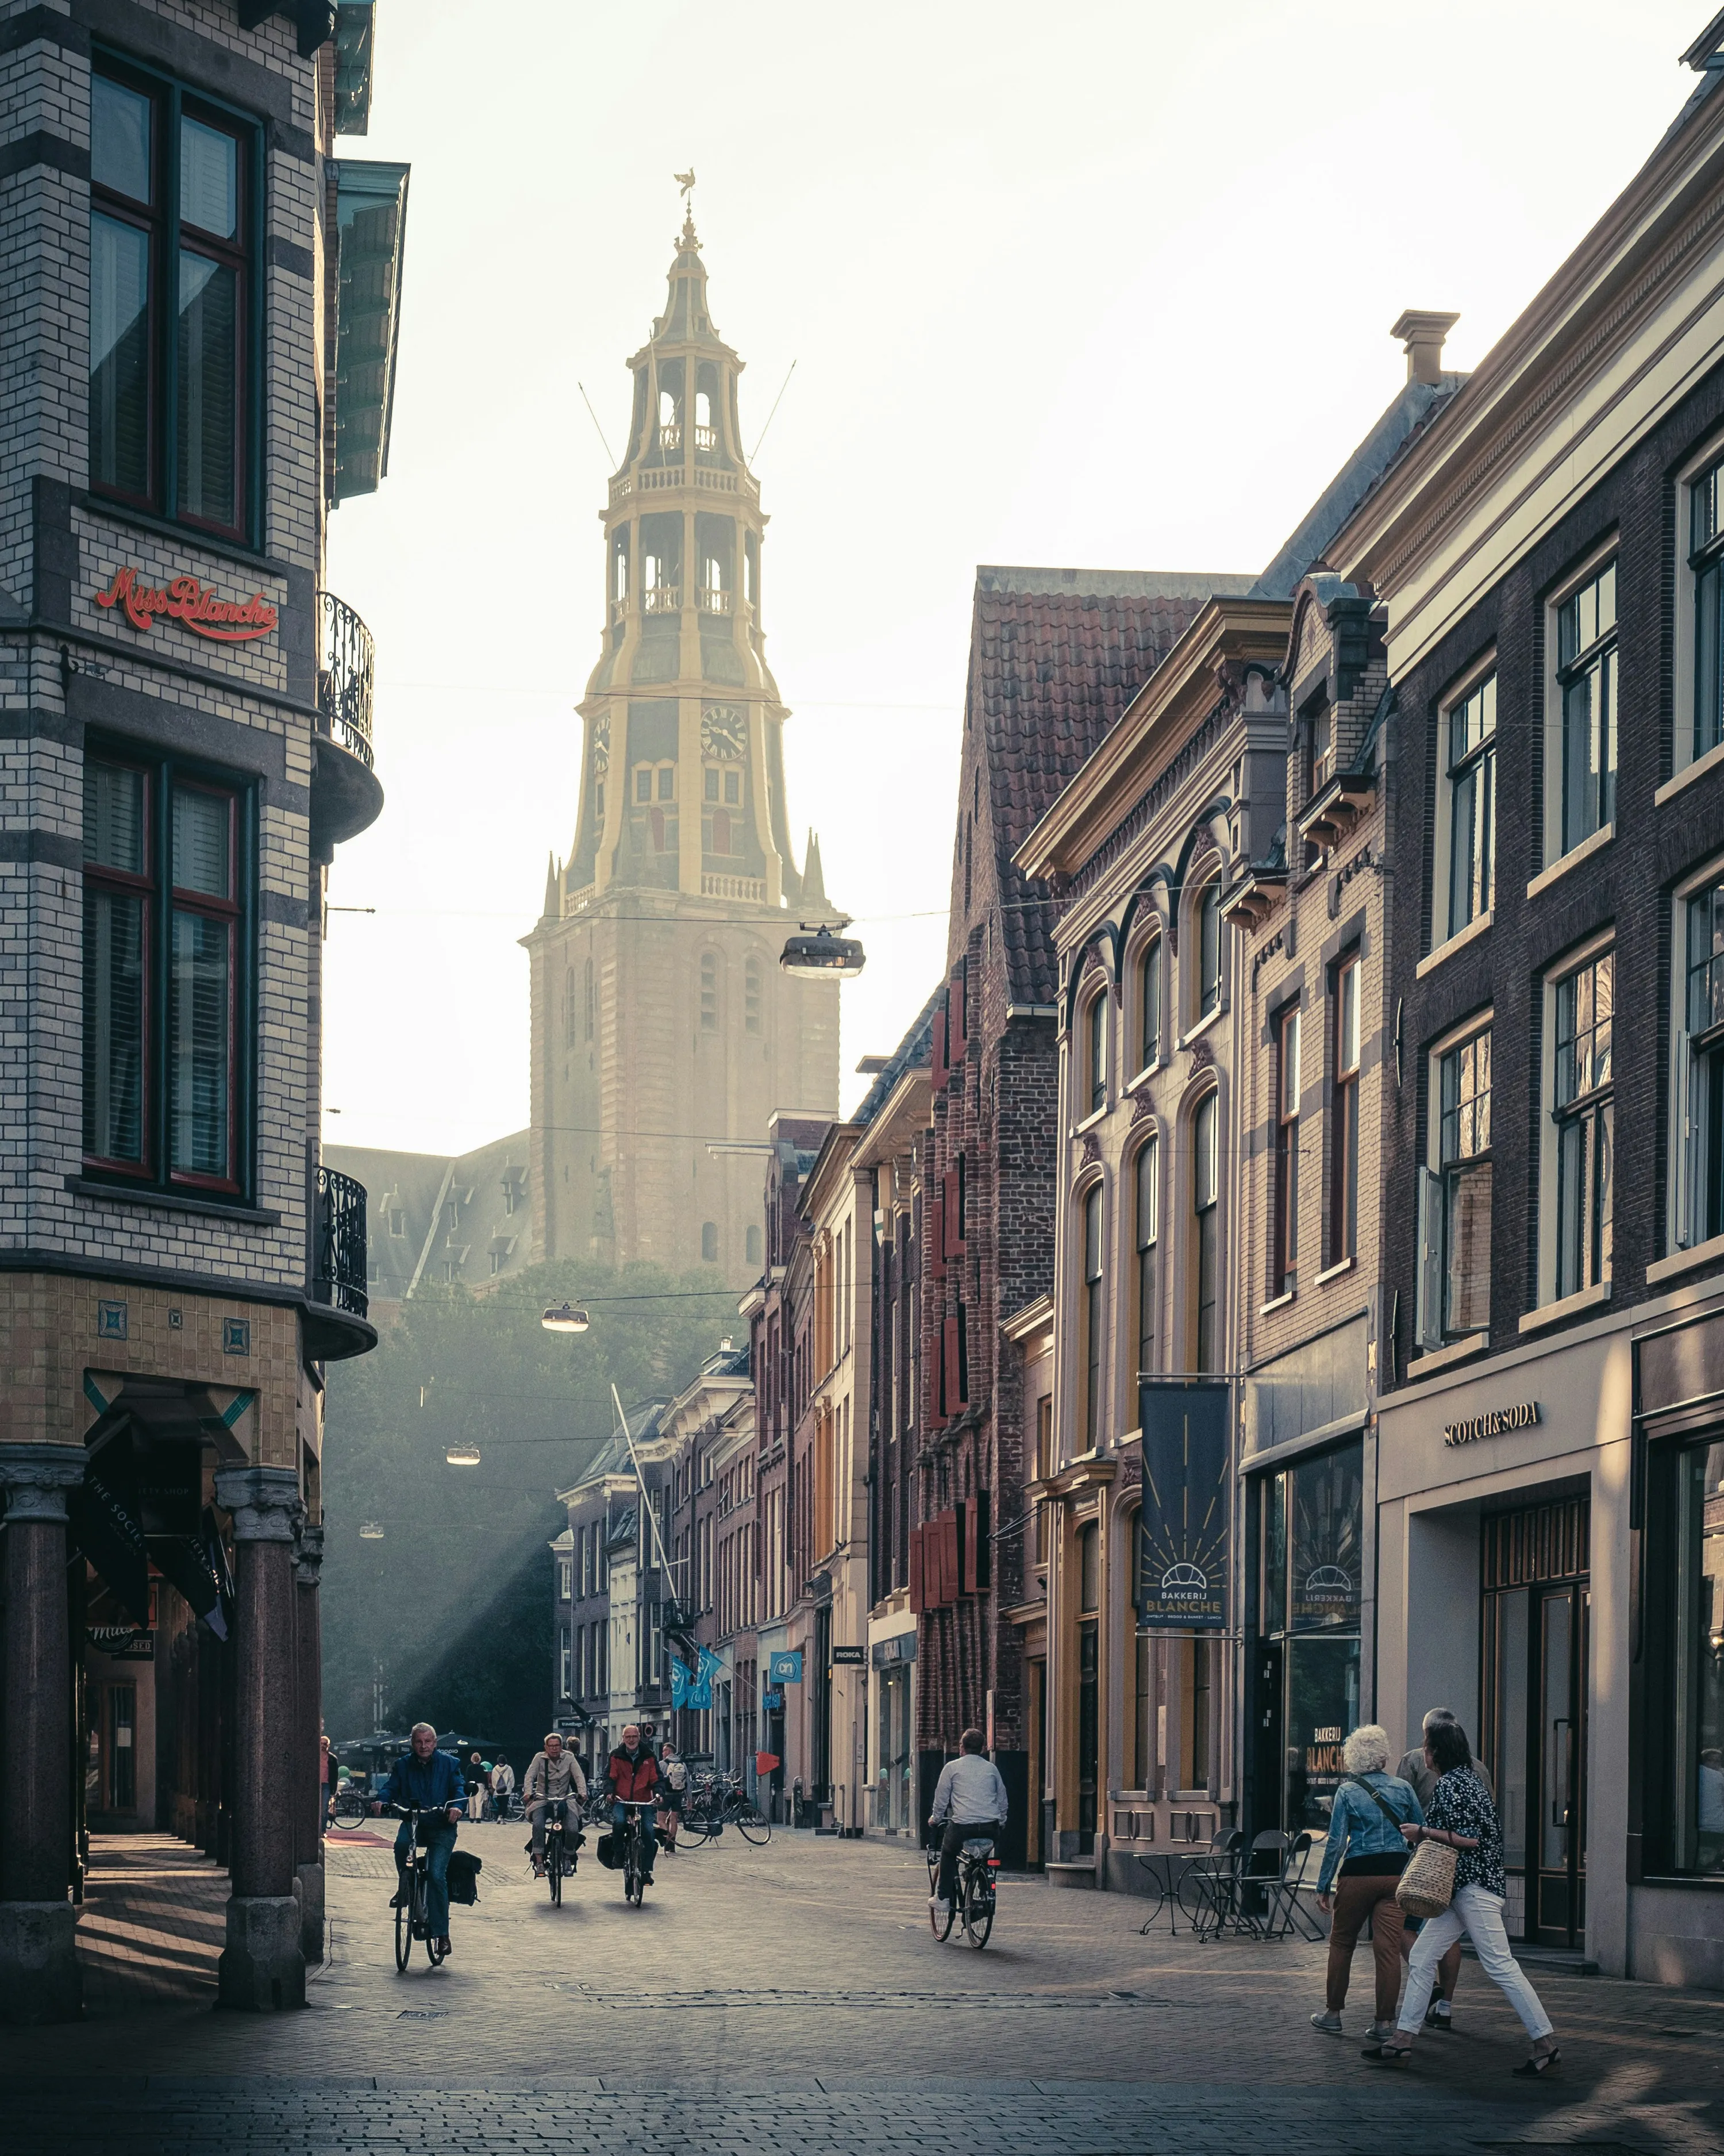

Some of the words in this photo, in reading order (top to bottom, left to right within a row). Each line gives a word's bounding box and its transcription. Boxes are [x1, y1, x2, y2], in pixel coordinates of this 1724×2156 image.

[94, 566, 168, 631] Miss
[167, 576, 279, 641] Blanche
[88, 1474, 111, 1501] THE
[1161, 1592, 1207, 1600] BAKKERIJ
[1146, 1600, 1222, 1613] BLANCHE
[1314, 1727, 1341, 1743] BAKKERIJ
